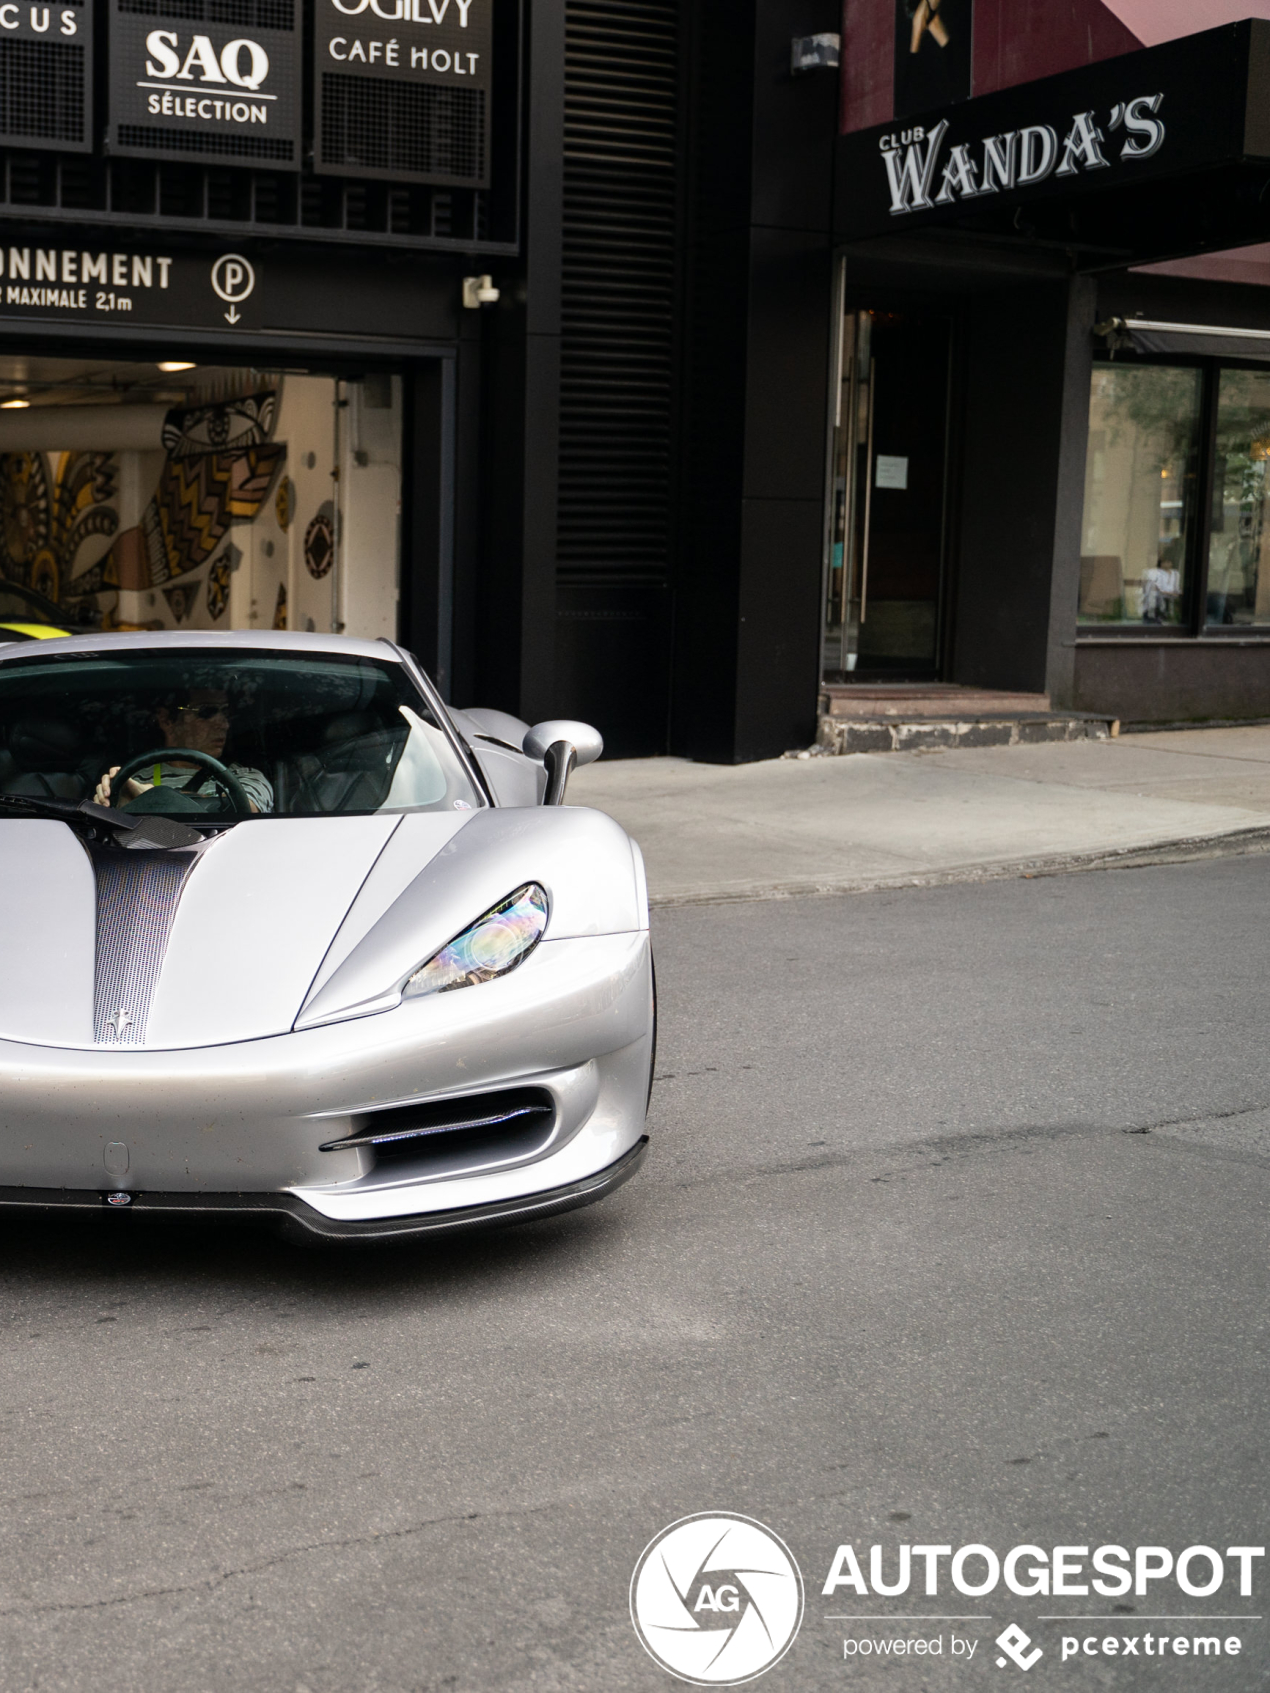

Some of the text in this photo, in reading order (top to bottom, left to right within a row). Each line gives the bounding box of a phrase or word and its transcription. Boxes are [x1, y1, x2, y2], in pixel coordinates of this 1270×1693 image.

[146, 29, 269, 91] SAQ
[329, 37, 480, 75] CAFÉ HOLT
[148, 92, 268, 125] SÉLECTION
[879, 126, 924, 151] CLUB
[881, 92, 1165, 216] WANDA'S
[7, 285, 87, 309] MAXIMALE
